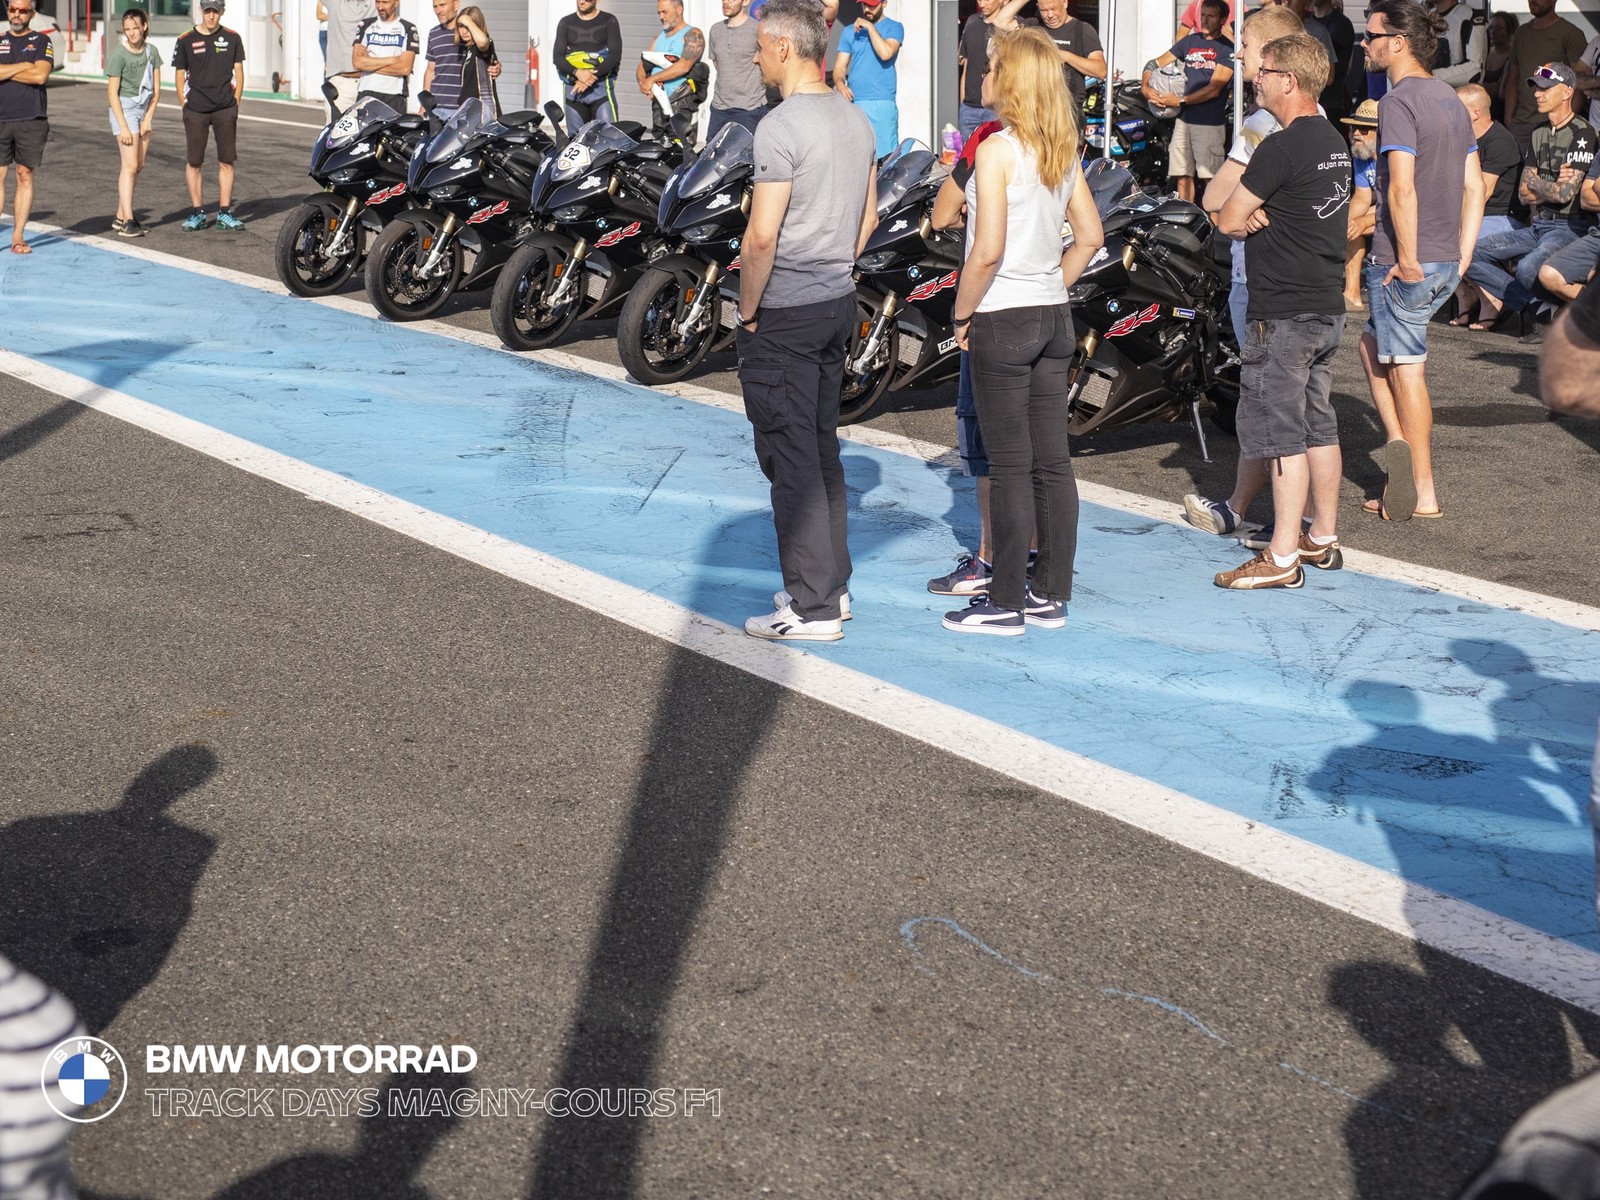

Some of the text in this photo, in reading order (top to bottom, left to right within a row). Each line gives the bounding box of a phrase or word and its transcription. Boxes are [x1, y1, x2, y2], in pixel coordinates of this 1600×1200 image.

[339, 120, 353, 132] 62
[564, 147, 580, 161] 32
[1330, 152, 1348, 160] circuit
[1566, 151, 1594, 164] CAMP
[1317, 161, 1337, 170] dijon
